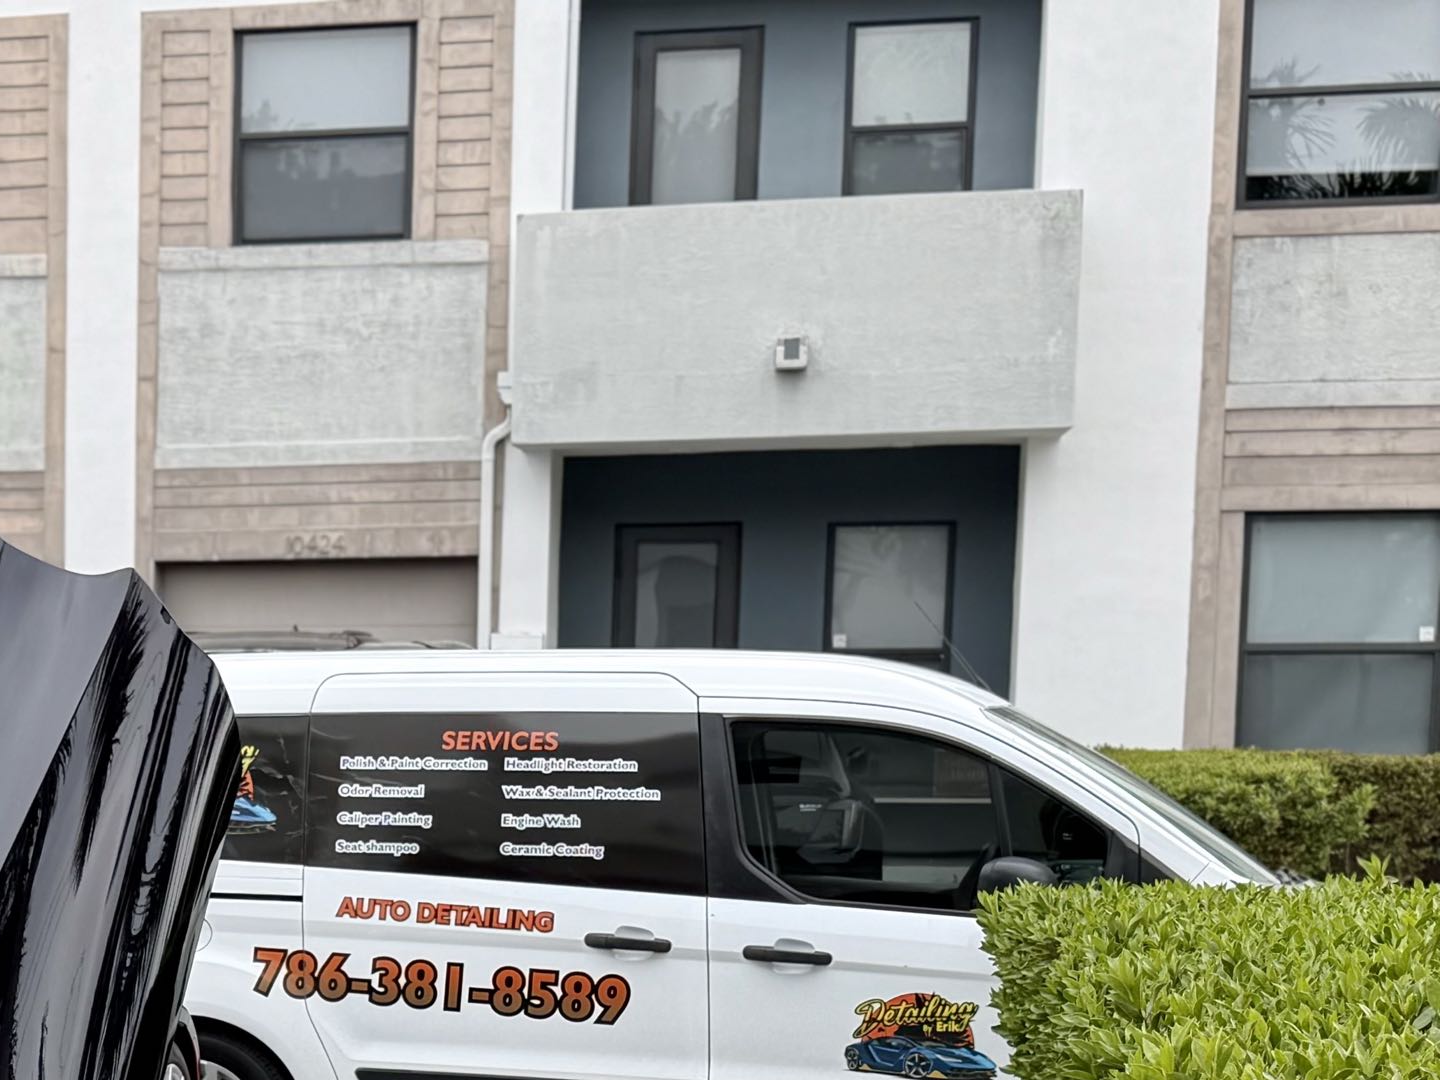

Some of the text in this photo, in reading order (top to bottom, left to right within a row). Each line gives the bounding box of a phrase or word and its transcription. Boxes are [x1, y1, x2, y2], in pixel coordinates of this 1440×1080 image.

[441, 730, 560, 751] SERVICES
[340, 756, 488, 770] Polish & Paint Correction
[504, 757, 638, 773] Headlight Restoration
[338, 784, 425, 798] Odor Removal
[502, 785, 660, 800] Wax & Sealant Protection
[337, 811, 432, 828] Caliper Painting
[501, 814, 580, 829] Engine Wash
[336, 840, 419, 856] Seat shampoo
[500, 842, 604, 859] Ceramic Coating
[336, 896, 555, 933] AUTO DETAILING
[252, 946, 631, 1026] 786-381-8589
[853, 995, 978, 1038] Detailing
[936, 1021, 959, 1032] Erik
